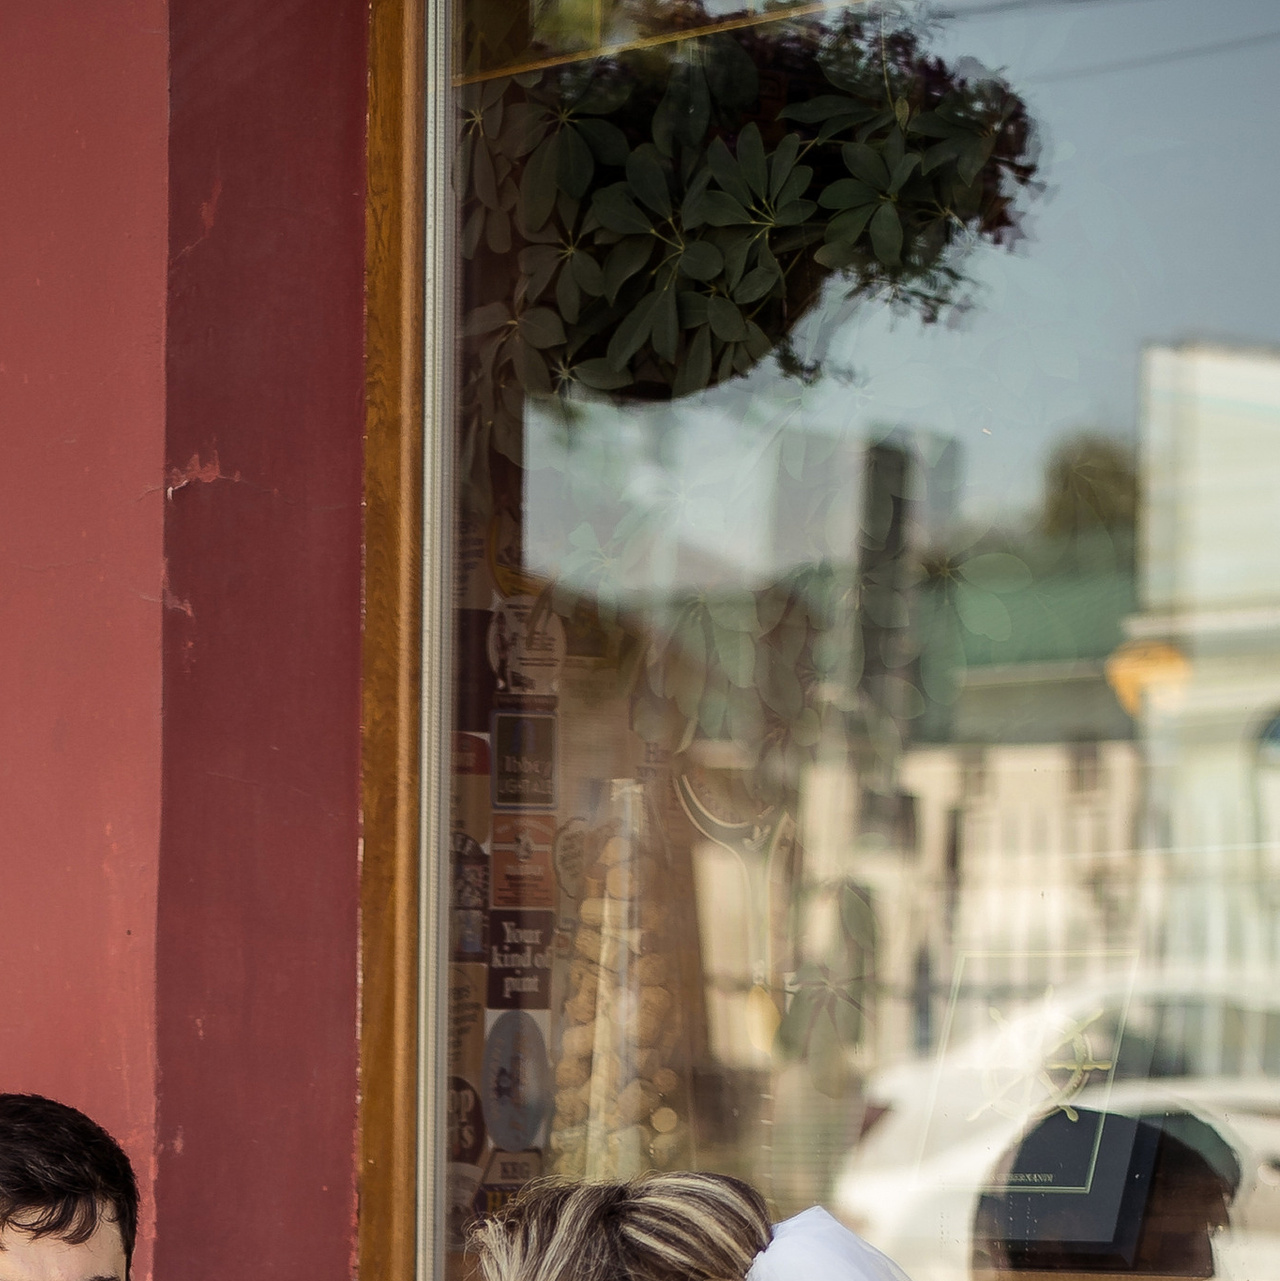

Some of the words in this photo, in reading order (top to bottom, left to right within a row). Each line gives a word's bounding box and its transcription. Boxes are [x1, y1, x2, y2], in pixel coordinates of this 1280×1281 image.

[502, 921, 542, 944] Your
[491, 945, 532, 968] kind
[534, 945, 553, 968] of
[503, 969, 540, 999] pint
